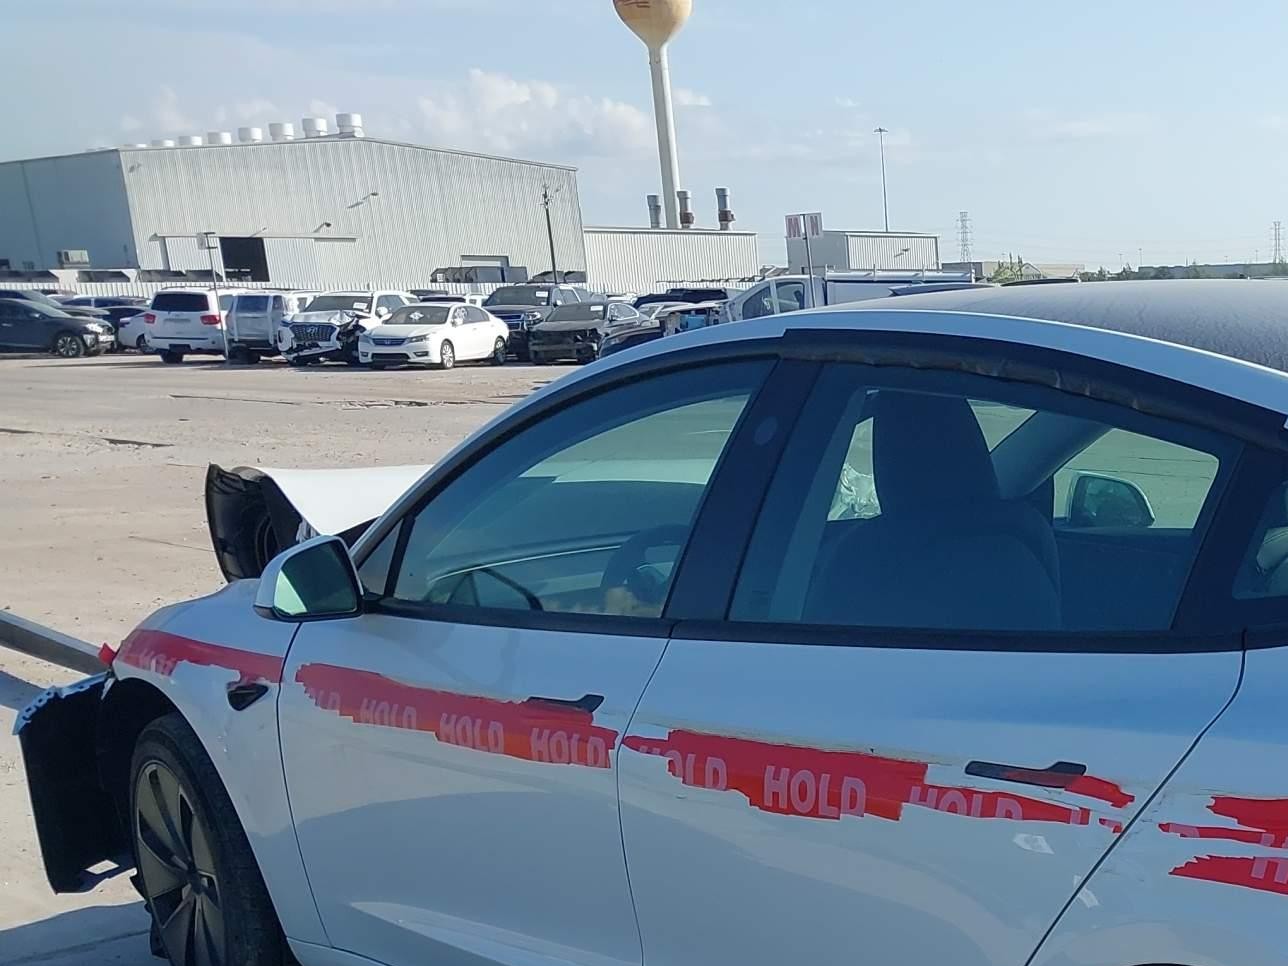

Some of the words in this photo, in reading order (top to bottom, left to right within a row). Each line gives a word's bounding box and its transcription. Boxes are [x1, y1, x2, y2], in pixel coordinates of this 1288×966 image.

[361, 697, 417, 729] HOLD
[439, 712, 504, 754] HOLD
[530, 727, 607, 768] HOLD
[764, 765, 867, 818] HOLD
